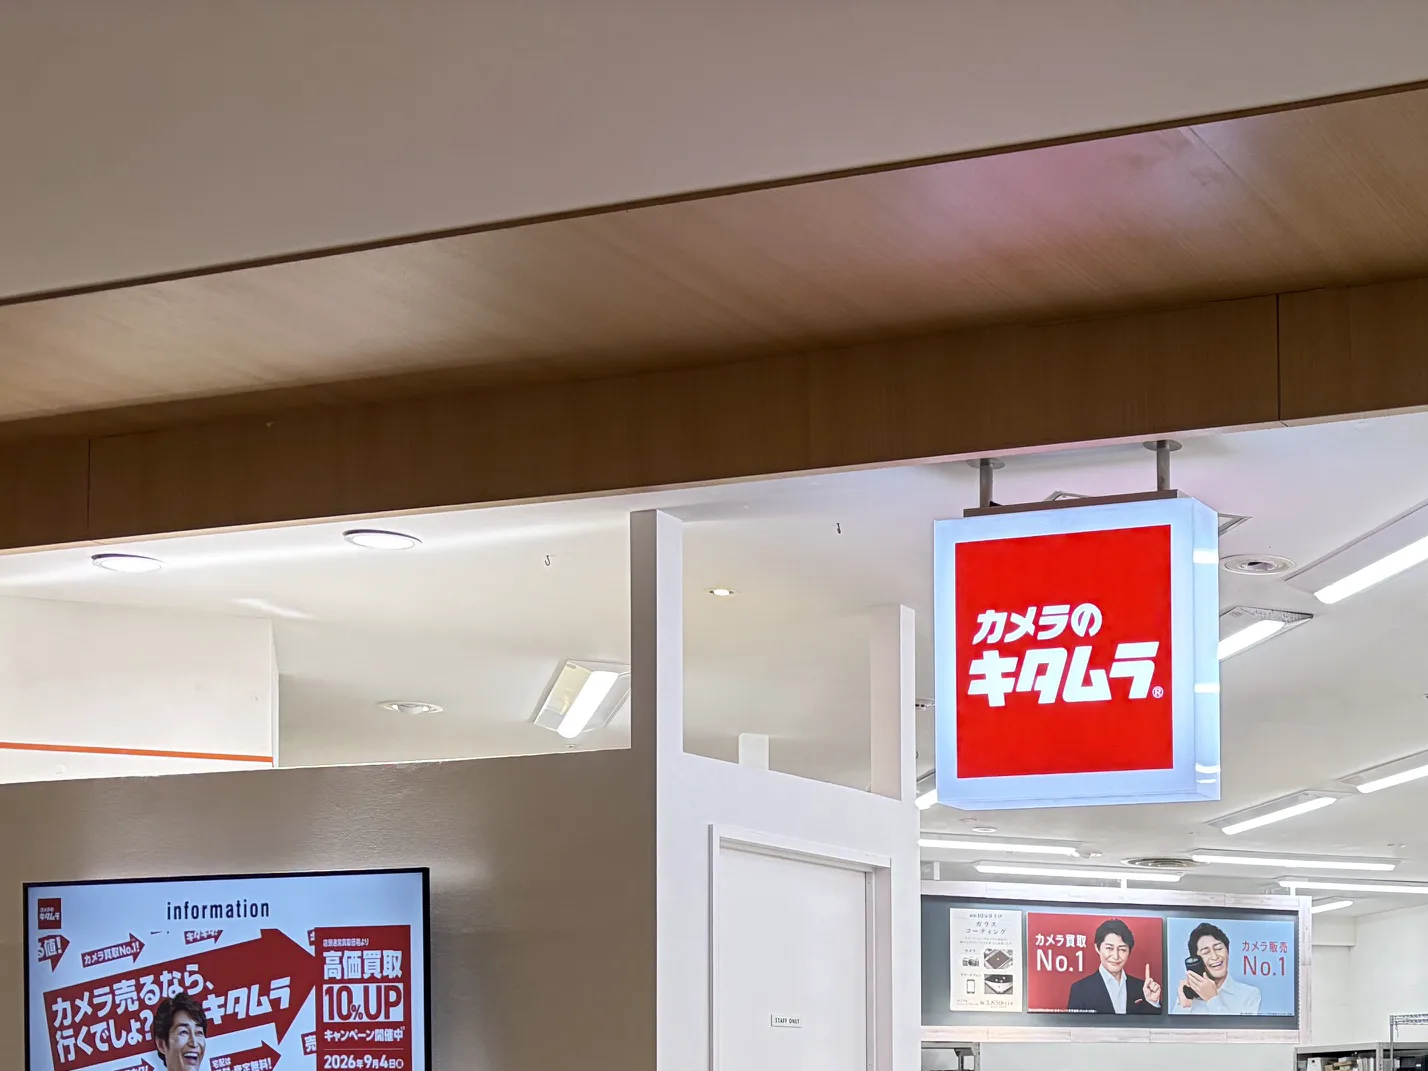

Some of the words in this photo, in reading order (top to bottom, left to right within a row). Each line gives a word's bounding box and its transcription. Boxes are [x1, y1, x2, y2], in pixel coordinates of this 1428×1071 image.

[972, 602, 1103, 645] カメラの
[38, 911, 61, 921] キタムラ
[166, 899, 270, 921] information
[1035, 933, 1087, 948] カメラ買取
[1241, 940, 1288, 953] カメラ販売
[322, 950, 403, 980] 高価買取
[1036, 949, 1084, 972] No.1
[1243, 955, 1286, 977] No.1
[51, 964, 215, 1029] カメラ売るなら、
[202, 976, 292, 1026] キタムラ
[324, 985, 403, 1021] 10%UP
[55, 1009, 155, 1064] 行くでしょ?
